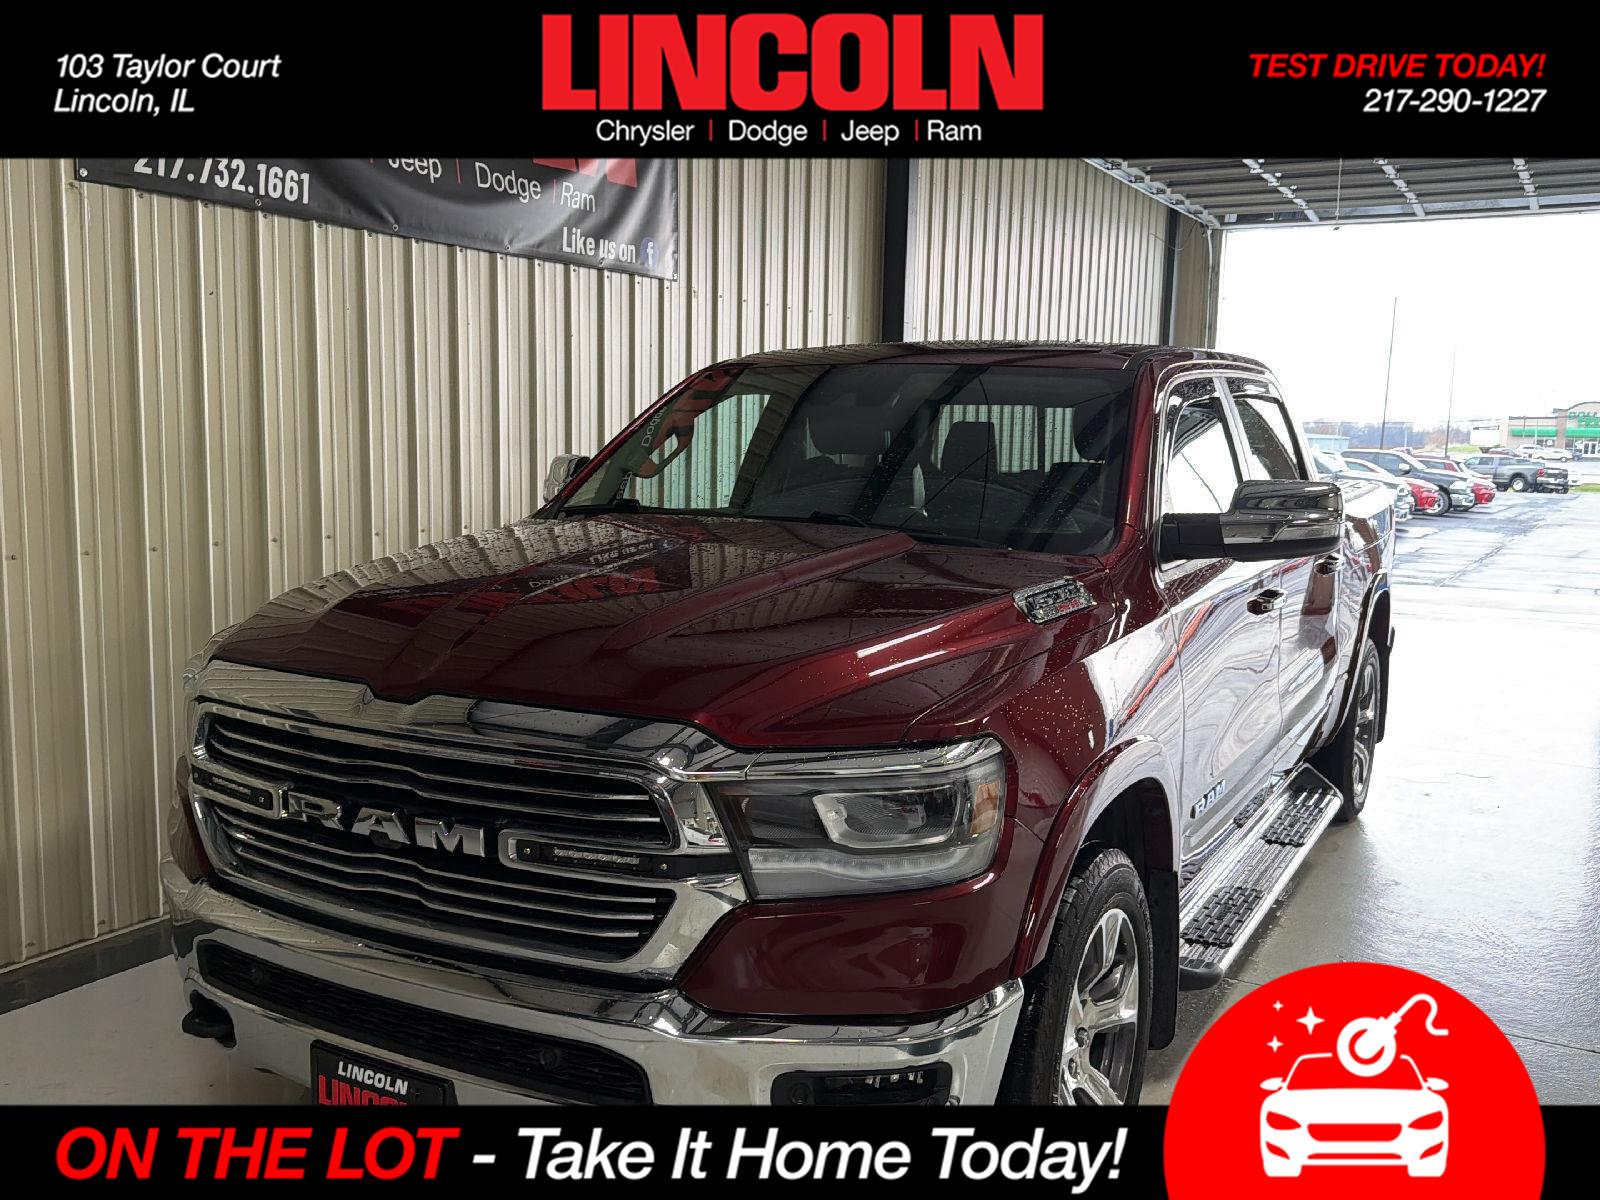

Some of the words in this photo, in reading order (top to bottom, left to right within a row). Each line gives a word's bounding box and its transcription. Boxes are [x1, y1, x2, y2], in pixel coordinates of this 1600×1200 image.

[474, 161, 541, 203] Dodge
[560, 181, 596, 213] Ram
[562, 226, 595, 257] Like
[600, 246, 616, 262] us
[619, 245, 636, 264] on
[1189, 779, 1226, 819] RAM
[288, 791, 485, 858] RAM
[337, 1060, 409, 1096] LINCOLN
